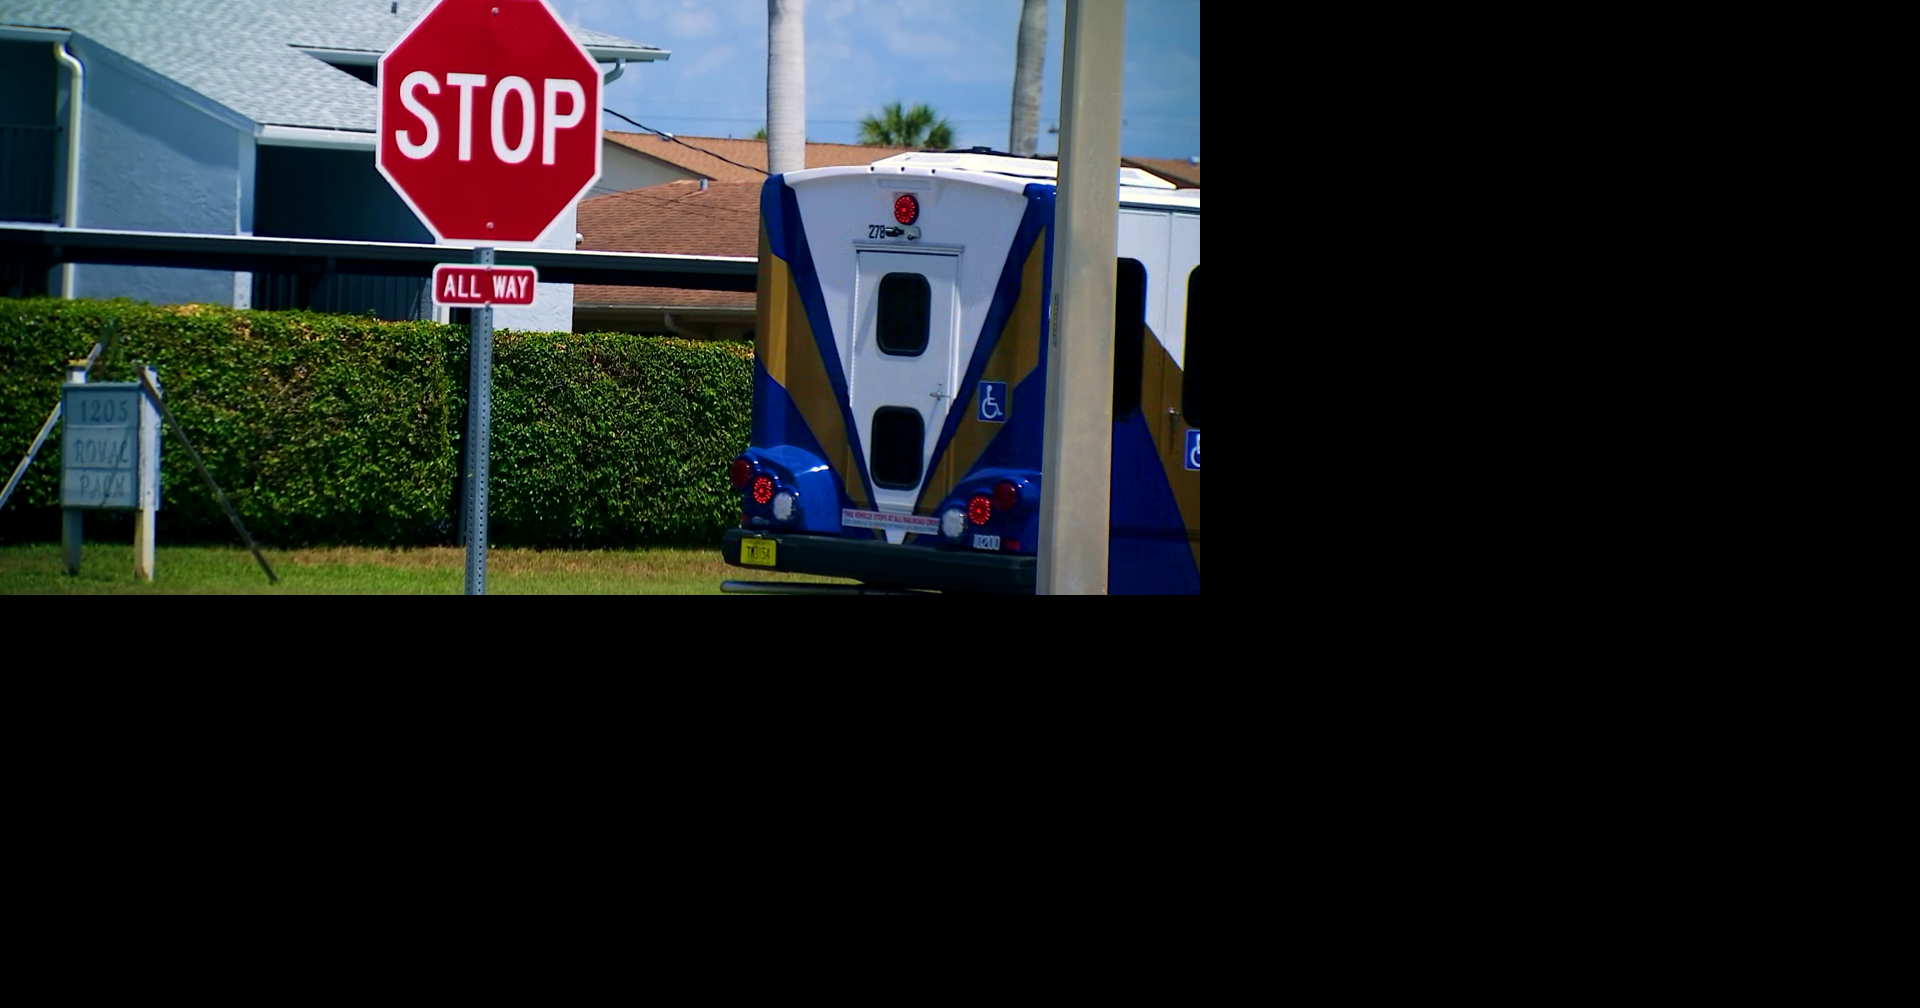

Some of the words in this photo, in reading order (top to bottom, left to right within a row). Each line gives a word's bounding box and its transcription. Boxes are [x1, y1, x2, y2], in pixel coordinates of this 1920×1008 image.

[395, 70, 586, 165] STOP
[868, 224, 885, 239] 278
[443, 274, 481, 298] ALL
[492, 275, 529, 299] WAY
[81, 399, 128, 423] 1205
